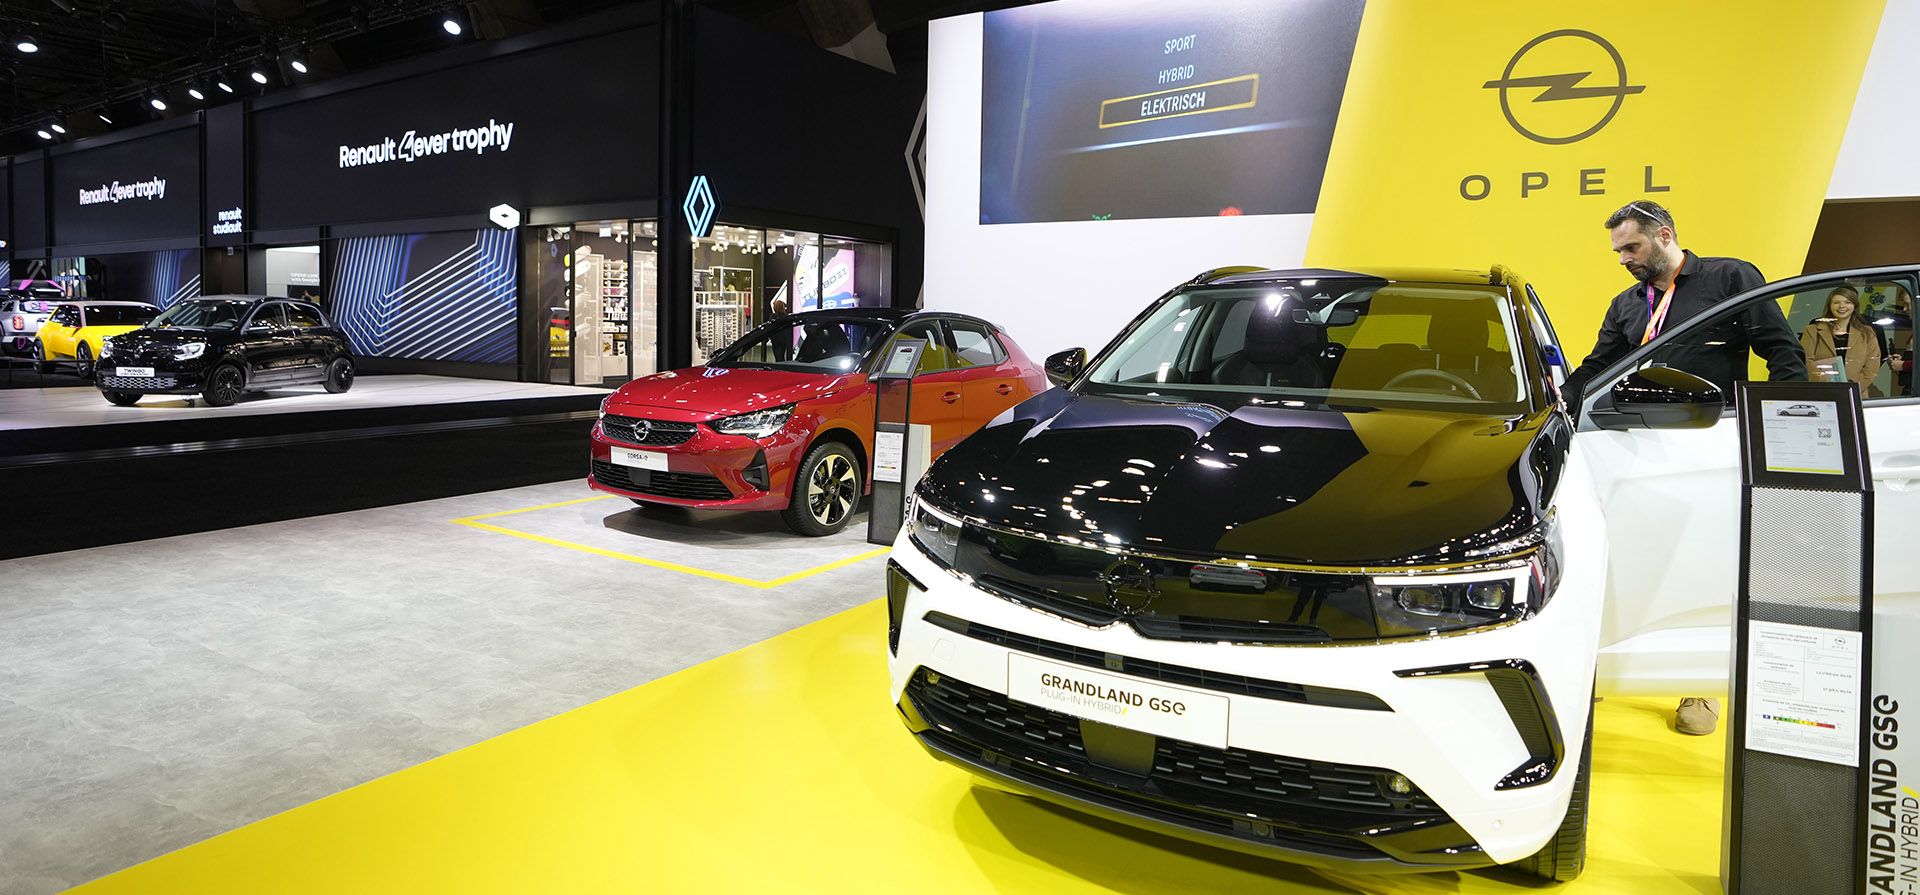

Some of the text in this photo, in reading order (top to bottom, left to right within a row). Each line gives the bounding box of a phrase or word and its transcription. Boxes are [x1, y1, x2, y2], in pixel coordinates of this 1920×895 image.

[1164, 34, 1197, 54] SPORT
[1158, 64, 1195, 84] HYBRID
[1140, 91, 1206, 117] ELEKTRISCH
[339, 137, 396, 168] Renault
[451, 118, 514, 155] trophy
[79, 184, 109, 205] Renault
[136, 175, 166, 200] trophy
[1459, 165, 1671, 201] OPEL
[218, 207, 242, 221] renault
[1040, 687, 1122, 715] PLUG-IN HYBRID
[1041, 673, 1186, 716] GRANDLAND GSe
[1869, 694, 1899, 895] ANDLAND GSe
[1900, 796, 1919, 861] HYBRID
